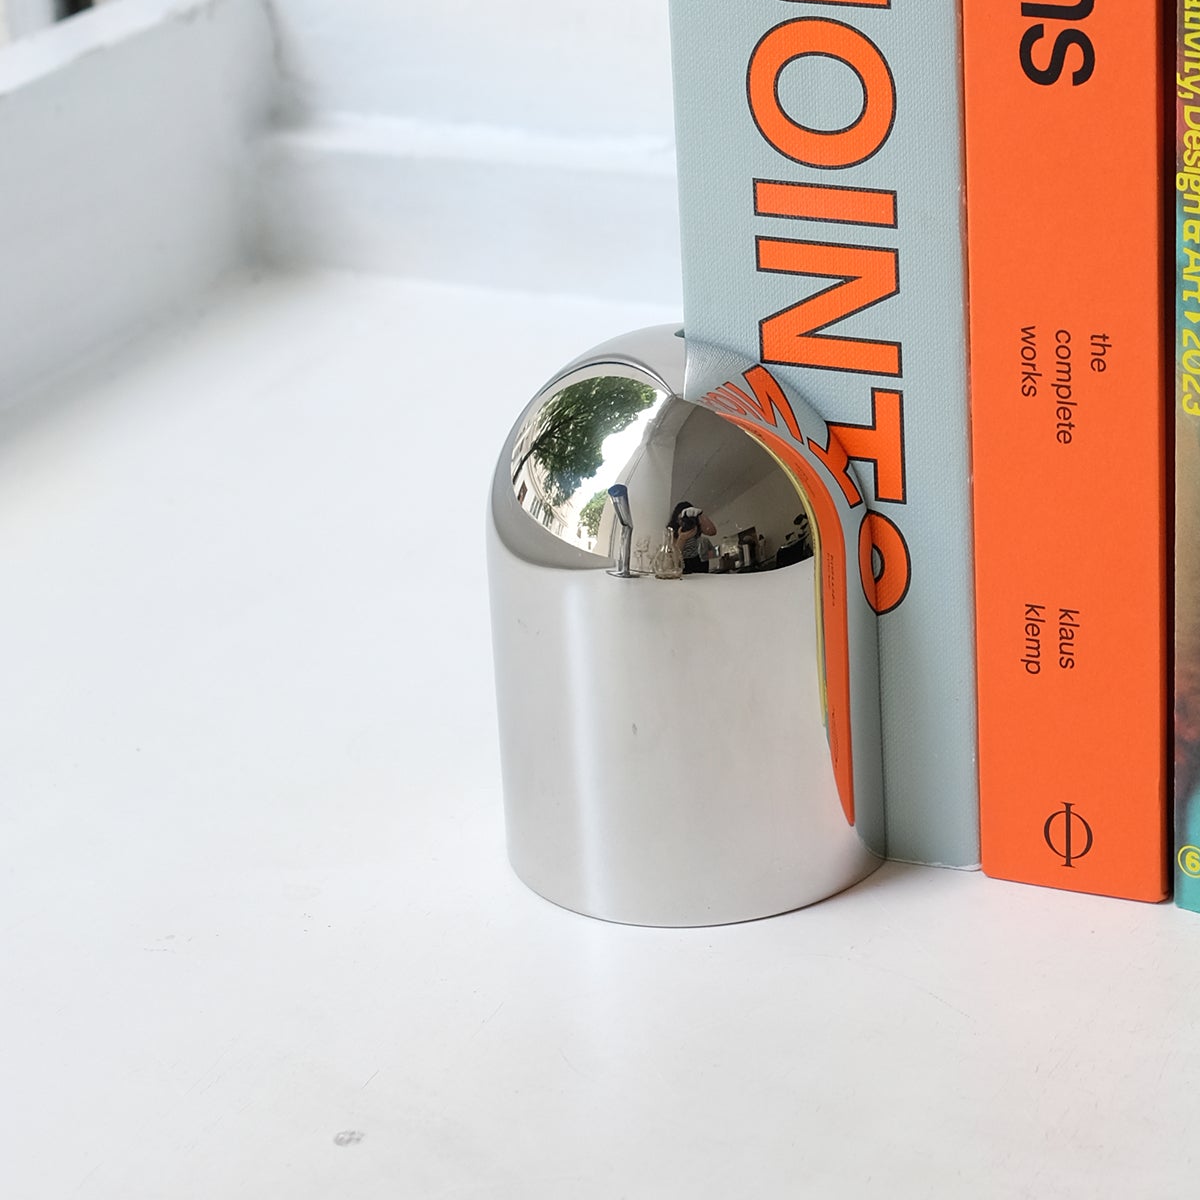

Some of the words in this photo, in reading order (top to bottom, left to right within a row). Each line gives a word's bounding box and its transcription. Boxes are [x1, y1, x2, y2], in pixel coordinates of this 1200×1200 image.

[1020, 325, 1042, 398] works
[1051, 329, 1077, 444] complete
[1090, 333, 1112, 373] the
[1021, 603, 1046, 675] klemp
[1059, 608, 1080, 670] klaus
